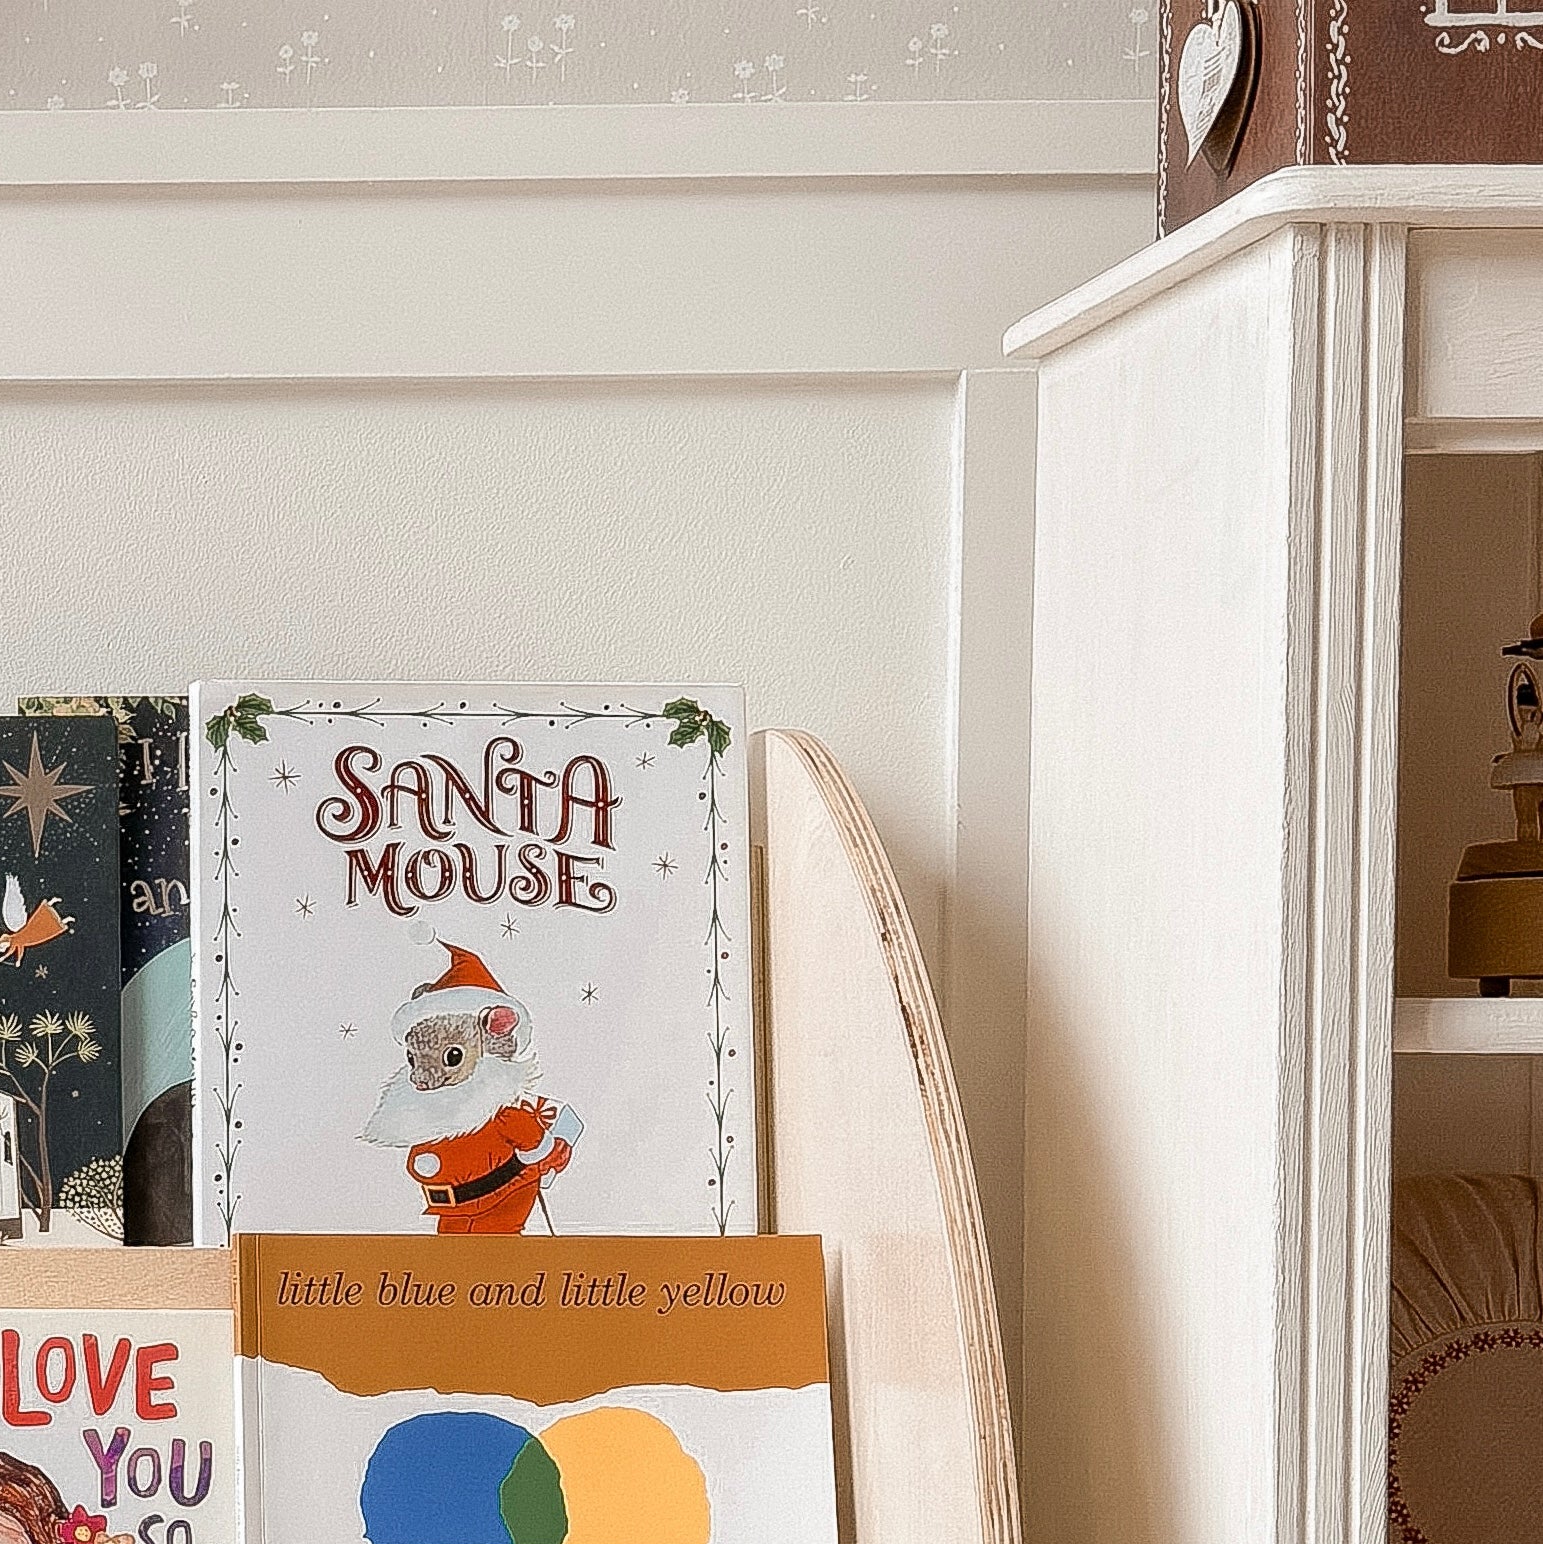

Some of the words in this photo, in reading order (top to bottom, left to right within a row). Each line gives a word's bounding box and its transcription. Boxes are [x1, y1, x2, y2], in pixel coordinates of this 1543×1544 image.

[316, 736, 623, 851] SANTA
[342, 842, 618, 917] MOUSE
[277, 1270, 363, 1307] little
[377, 1270, 456, 1307] blue
[468, 1272, 546, 1308] and
[560, 1272, 647, 1308] little
[656, 1272, 786, 1315] yellow
[1, 1328, 179, 1427] LOVE
[83, 1427, 213, 1509] YOU
